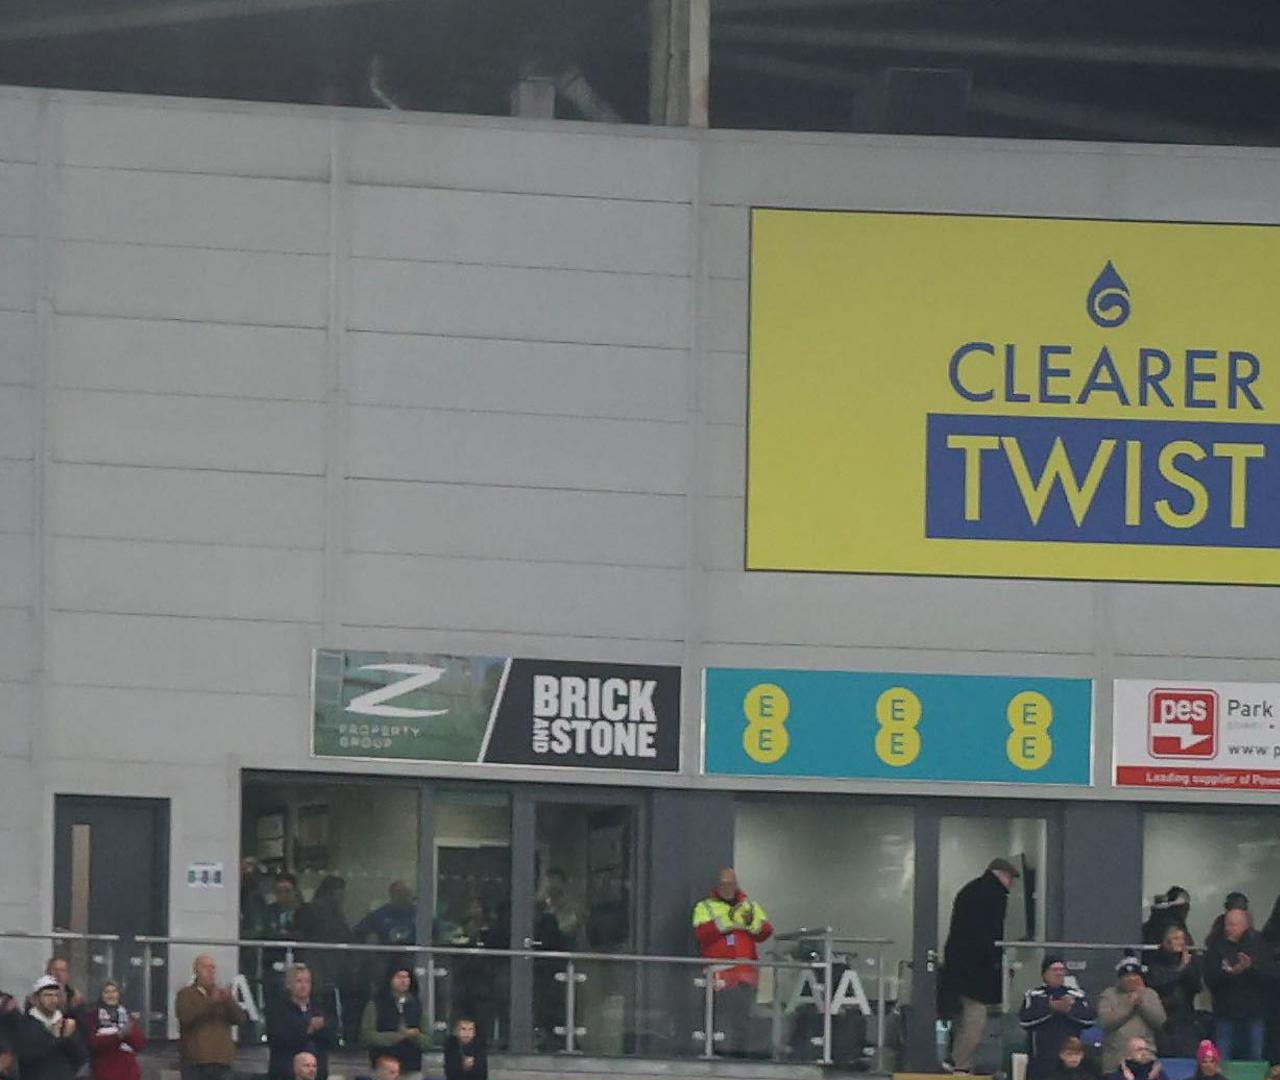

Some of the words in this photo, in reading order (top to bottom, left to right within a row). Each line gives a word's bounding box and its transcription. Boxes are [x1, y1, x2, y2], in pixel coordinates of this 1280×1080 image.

[948, 341, 1264, 411] CLEARER
[947, 435, 1264, 529] TWIST
[533, 674, 658, 722] BRICK
[1227, 699, 1273, 718] Park
[1159, 699, 1207, 726] pes
[339, 724, 420, 738] PROPERTY
[339, 736, 392, 749] GROUP
[549, 720, 658, 758] STONE
[1145, 772, 1189, 786] Leading
